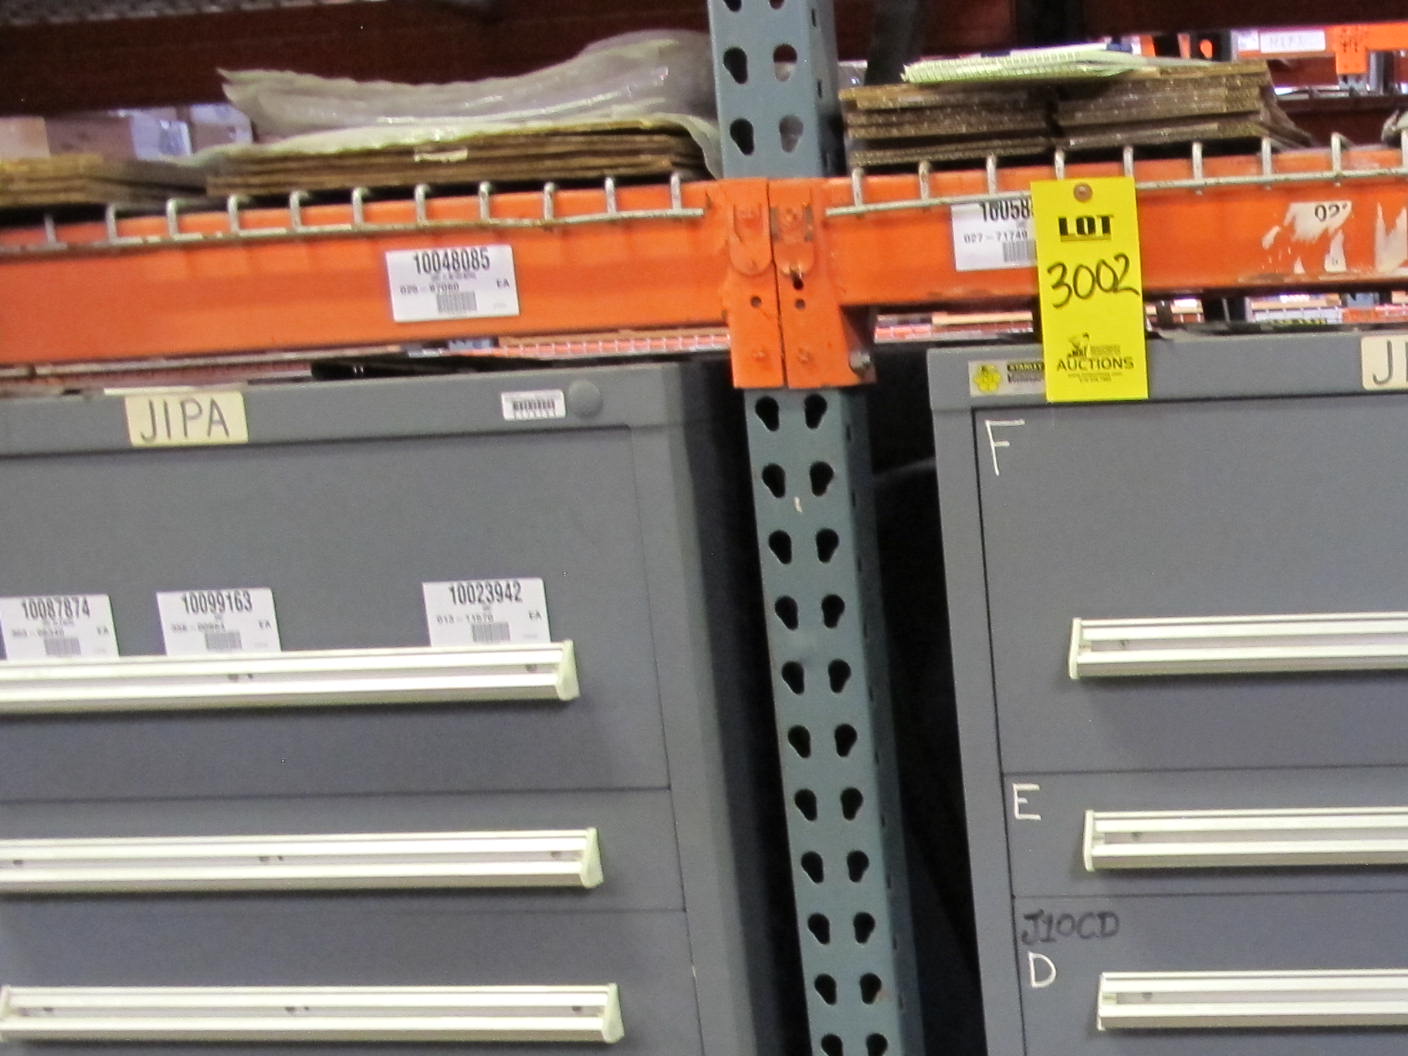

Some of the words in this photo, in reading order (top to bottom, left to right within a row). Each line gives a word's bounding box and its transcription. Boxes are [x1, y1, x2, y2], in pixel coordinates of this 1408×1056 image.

[1058, 213, 1115, 236] LOT
[413, 247, 491, 275] 10048085
[1047, 252, 1141, 309] 3002
[1057, 356, 1135, 372] AUCTIONS
[985, 420, 1026, 476] F
[182, 589, 253, 614] 10099163
[449, 581, 523, 605] 10023942
[21, 595, 91, 620] 10087874
[1012, 783, 1042, 821] E
[1027, 950, 1057, 989] D
